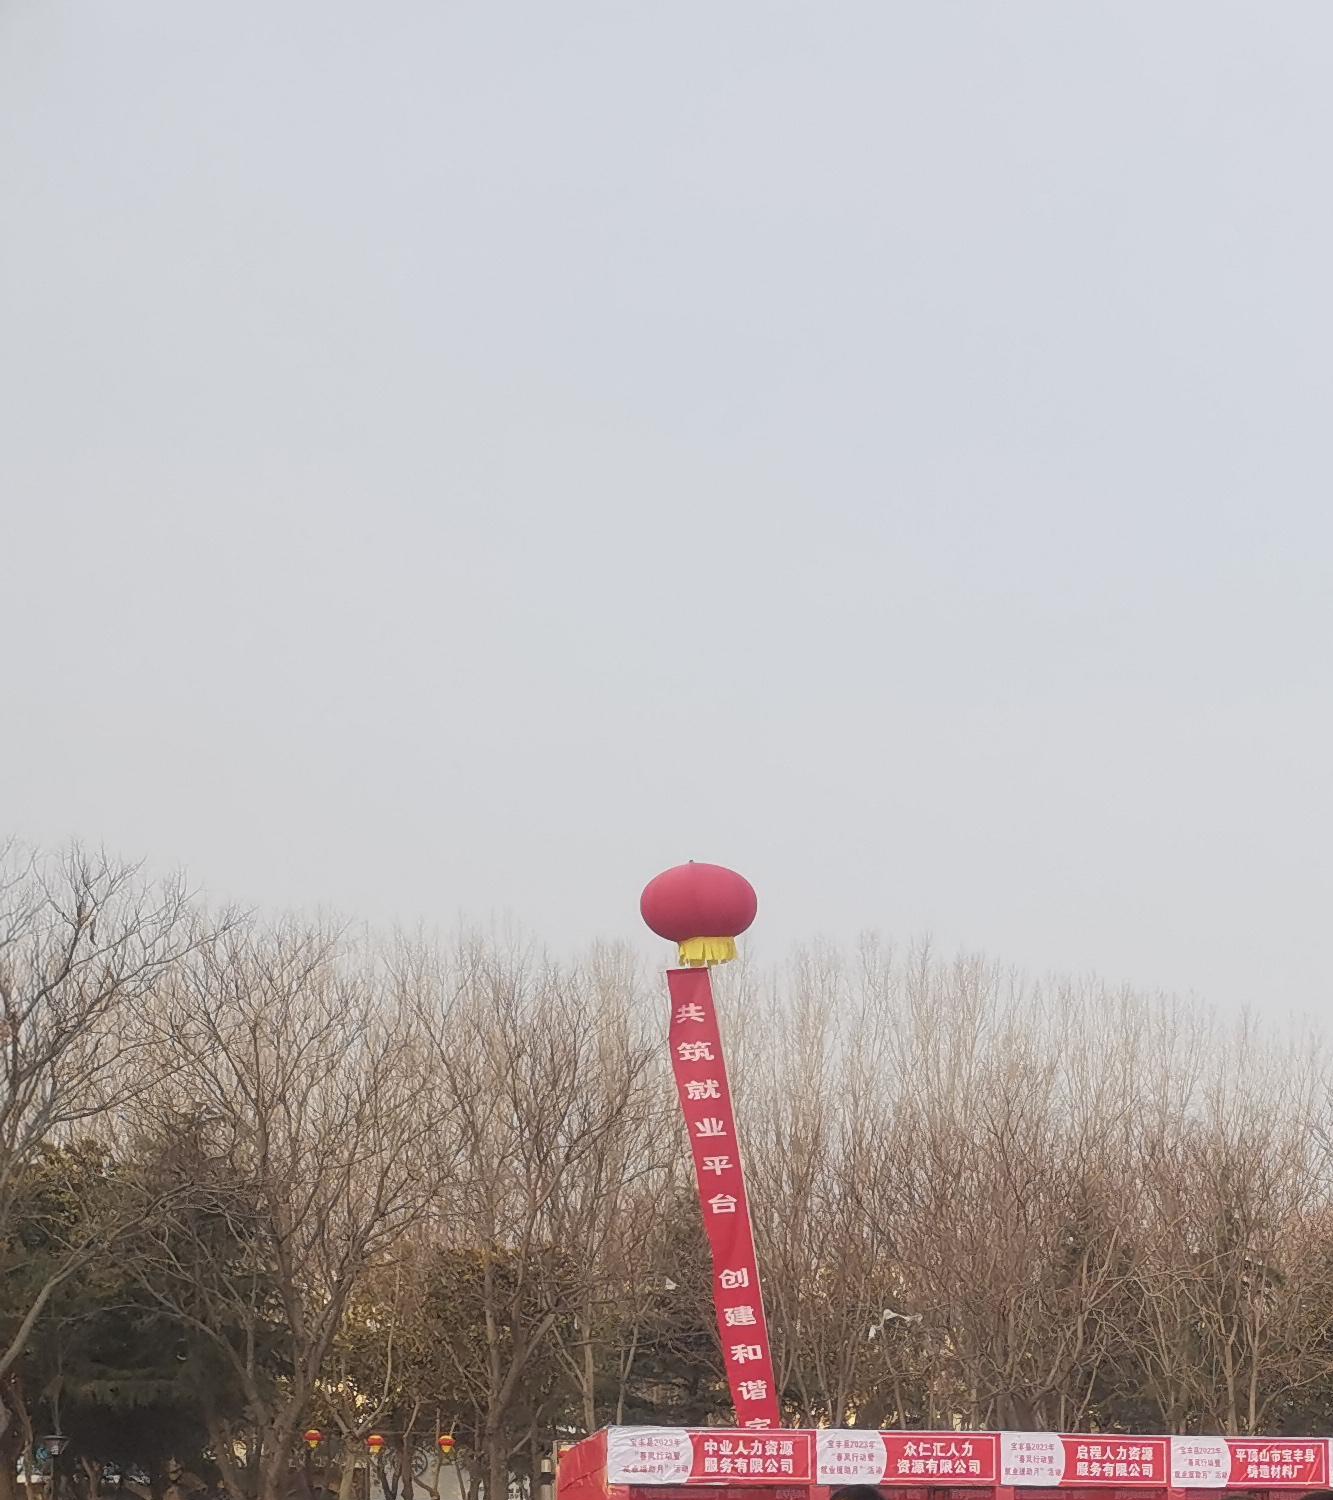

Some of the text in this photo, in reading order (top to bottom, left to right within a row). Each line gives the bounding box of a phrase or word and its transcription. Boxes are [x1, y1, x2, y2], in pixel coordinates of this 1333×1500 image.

[676, 1003, 738, 1214] 共筑就业平台
[704, 1439, 794, 1456] 中业人力资源
[904, 1442, 973, 1457] 众仁汇人力
[1076, 1445, 1153, 1460] 启程人力资源
[1236, 1448, 1315, 1463] 平顶山市宝丰县
[704, 1458, 794, 1474] 服务有限公司
[897, 1459, 981, 1474] 资源有限公司
[1077, 1462, 1153, 1478] 服务有限公司
[1247, 1465, 1304, 1479] 铸造材料厂
